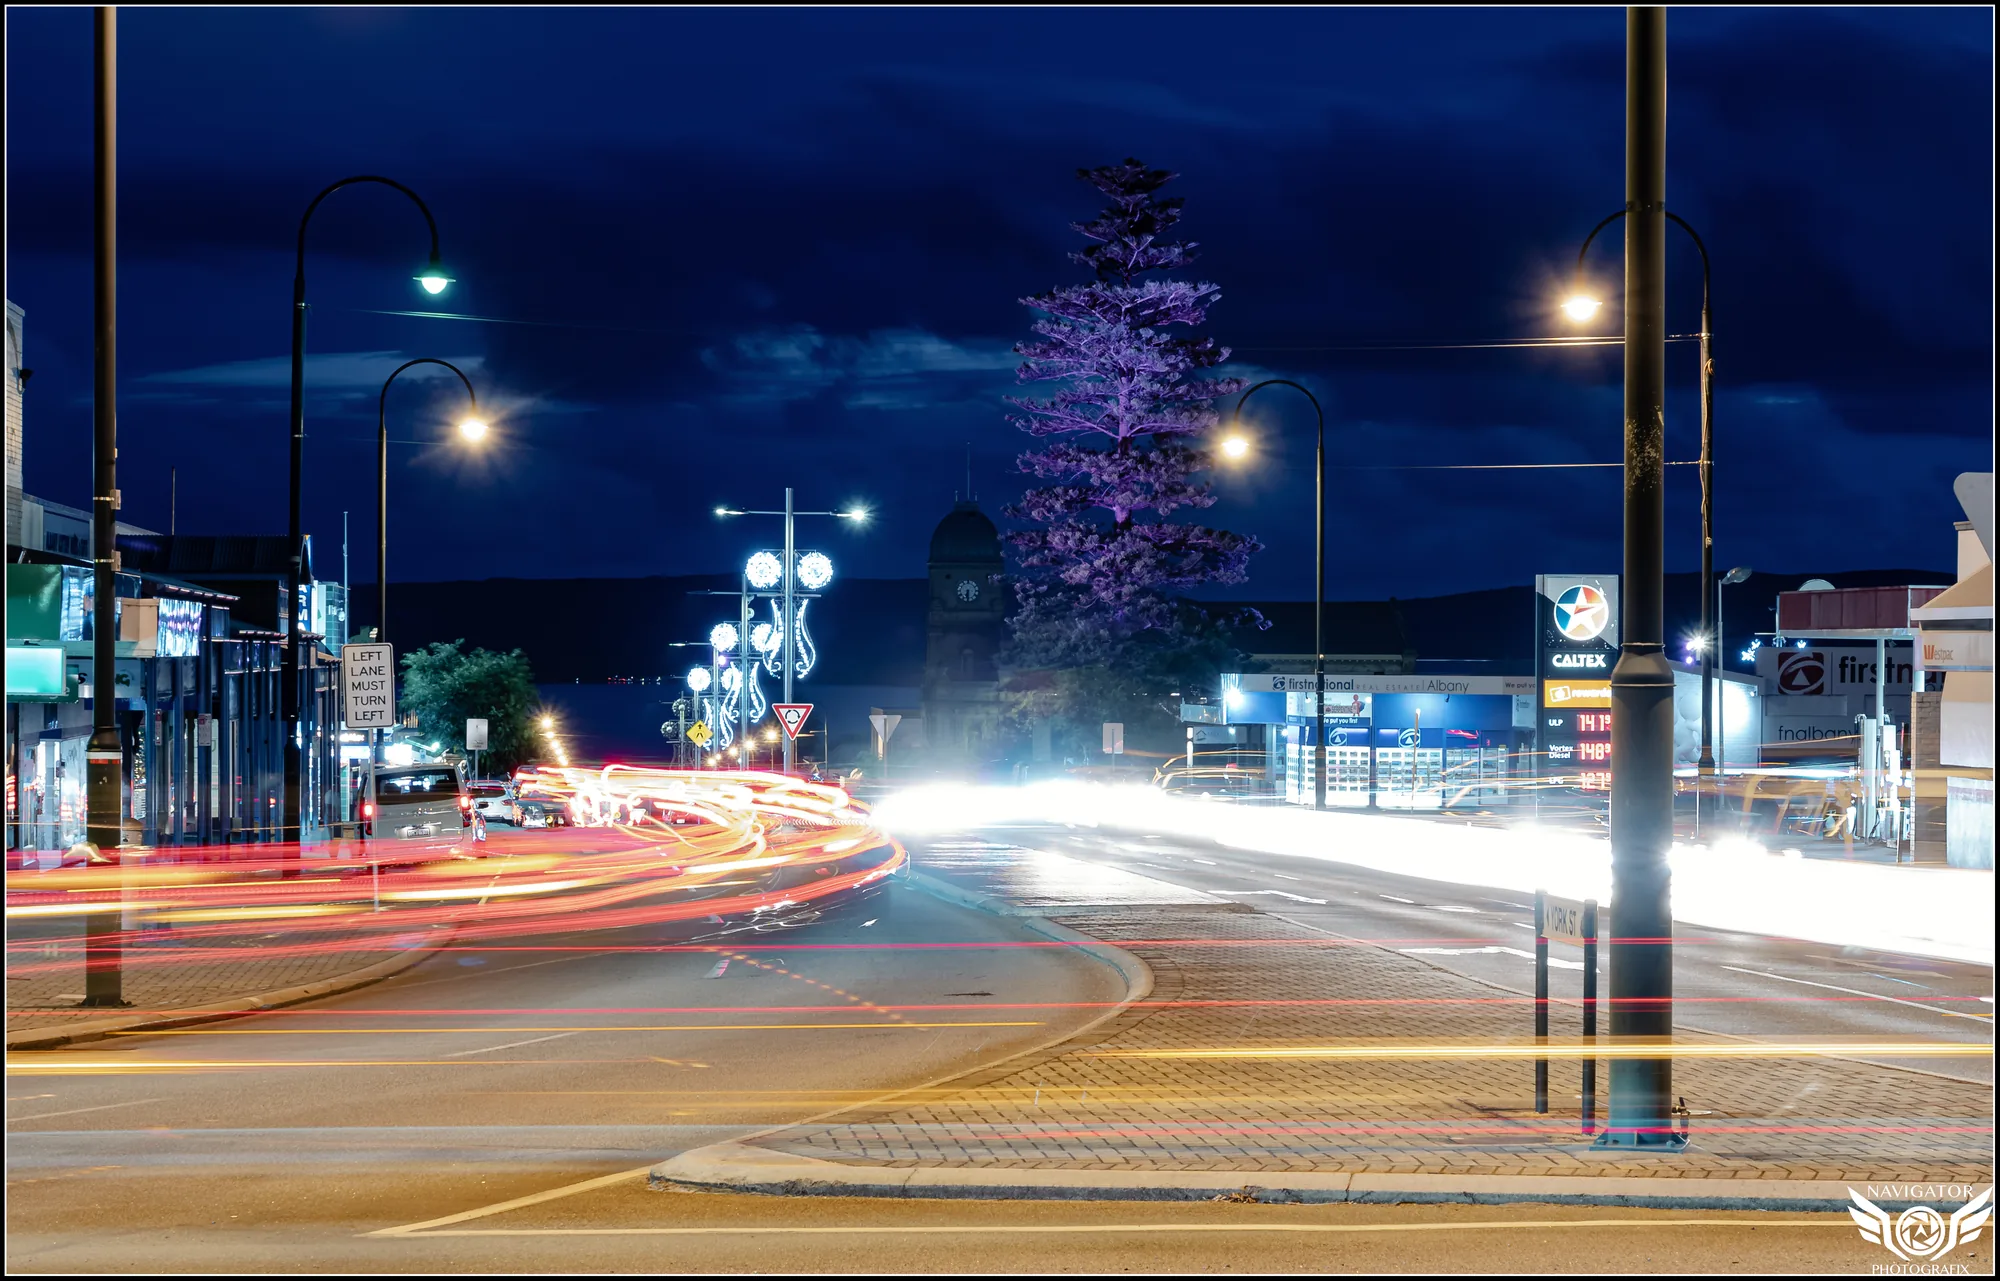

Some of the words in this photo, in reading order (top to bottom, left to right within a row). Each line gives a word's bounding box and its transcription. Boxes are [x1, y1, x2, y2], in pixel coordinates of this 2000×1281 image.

[353, 651, 382, 661] LEFT
[1924, 645, 1953, 663] Westpac
[1552, 653, 1607, 668] CALTEX
[351, 666, 385, 676] LANE
[352, 681, 385, 691] MUST
[1289, 678, 1354, 691] firstnional
[1427, 680, 1469, 694] Albany
[353, 695, 386, 705] TURN
[355, 710, 384, 721] LEFT
[1548, 718, 1563, 727] ULP
[1549, 744, 1573, 752] Vortex
[1551, 906, 1568, 934] YORK
[1569, 910, 1577, 936] ST
